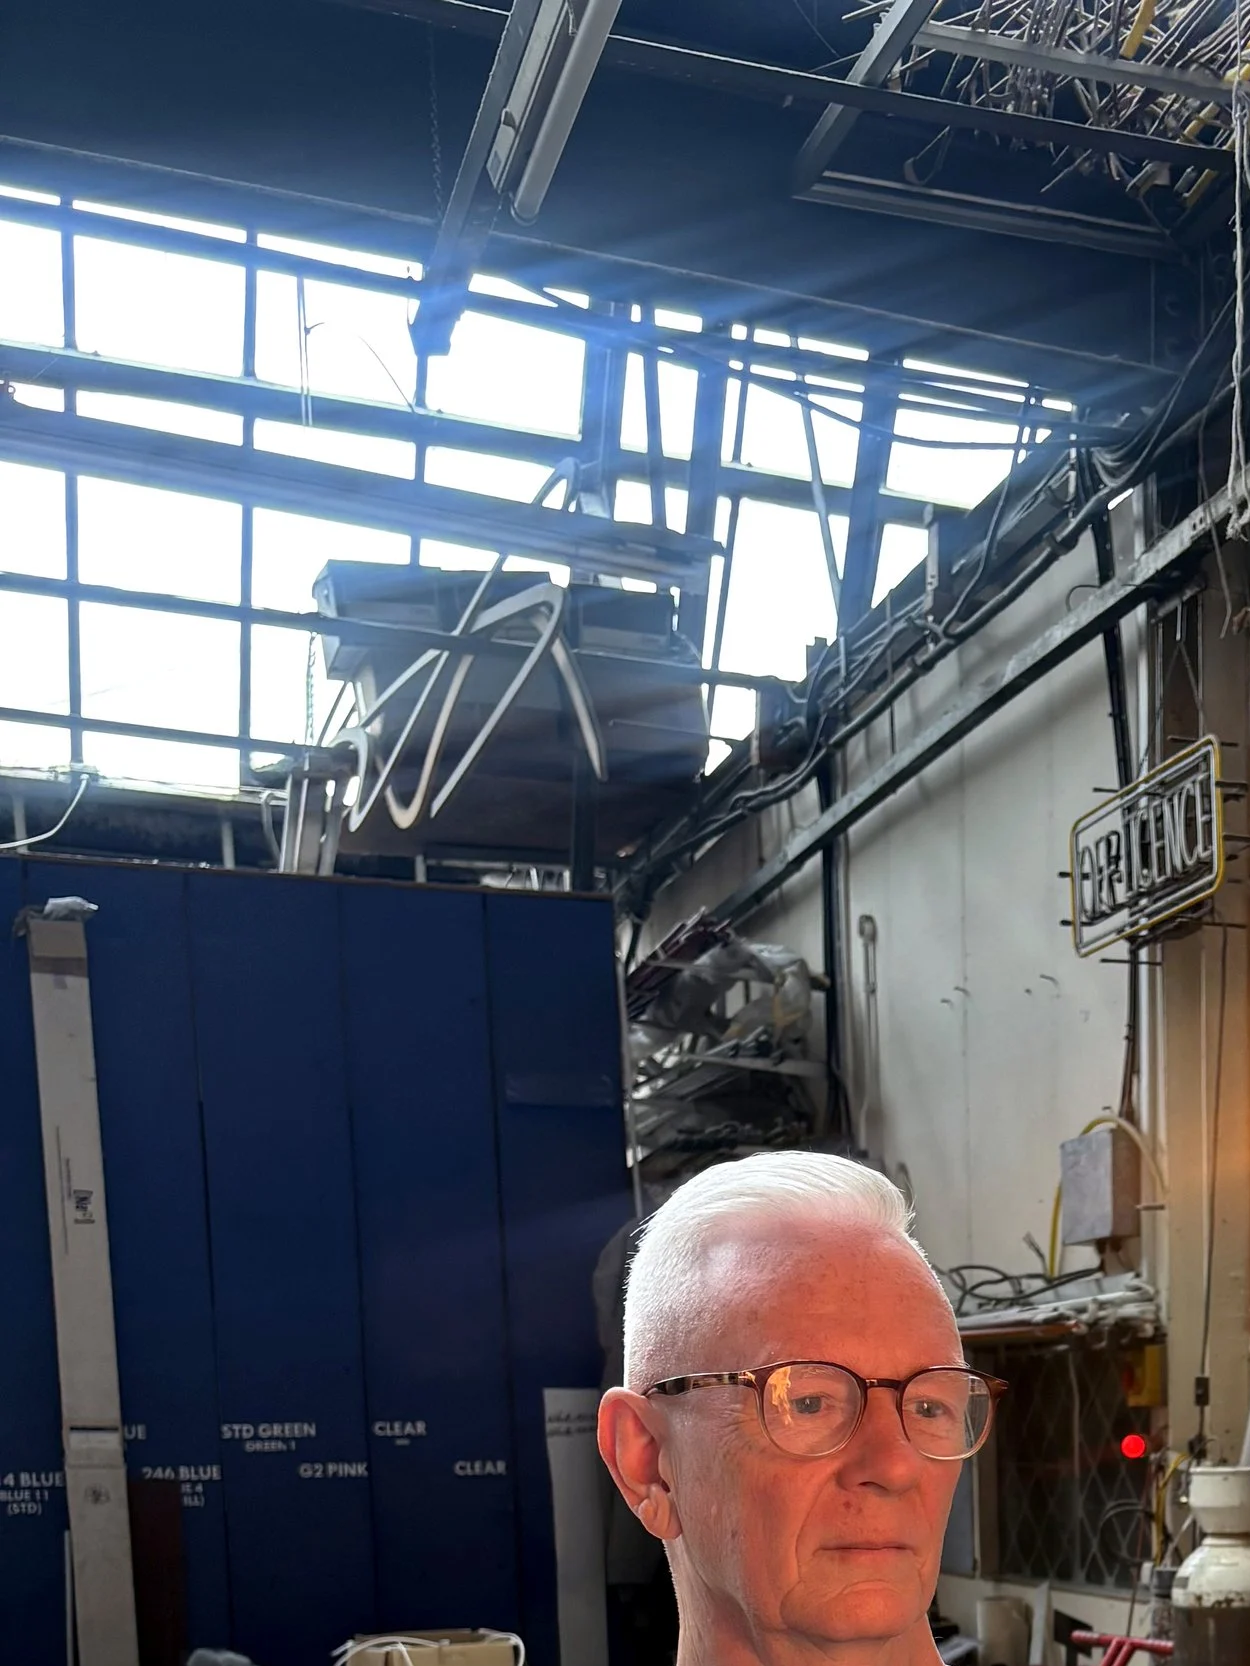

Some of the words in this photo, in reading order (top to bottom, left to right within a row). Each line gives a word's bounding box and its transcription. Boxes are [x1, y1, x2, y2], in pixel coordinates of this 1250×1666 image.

[124, 1424, 147, 1440] UE
[221, 1423, 255, 1439] STD
[258, 1422, 317, 1438] GREEN
[373, 1421, 427, 1437] CLEAR
[178, 1465, 222, 1481] BLUE
[299, 1463, 324, 1478] G2
[328, 1462, 369, 1478] PINK
[454, 1460, 507, 1476] CLEAR
[0, 1472, 15, 1488] 4
[20, 1471, 65, 1488] BLUE
[7, 1502, 43, 1517] (STD)
